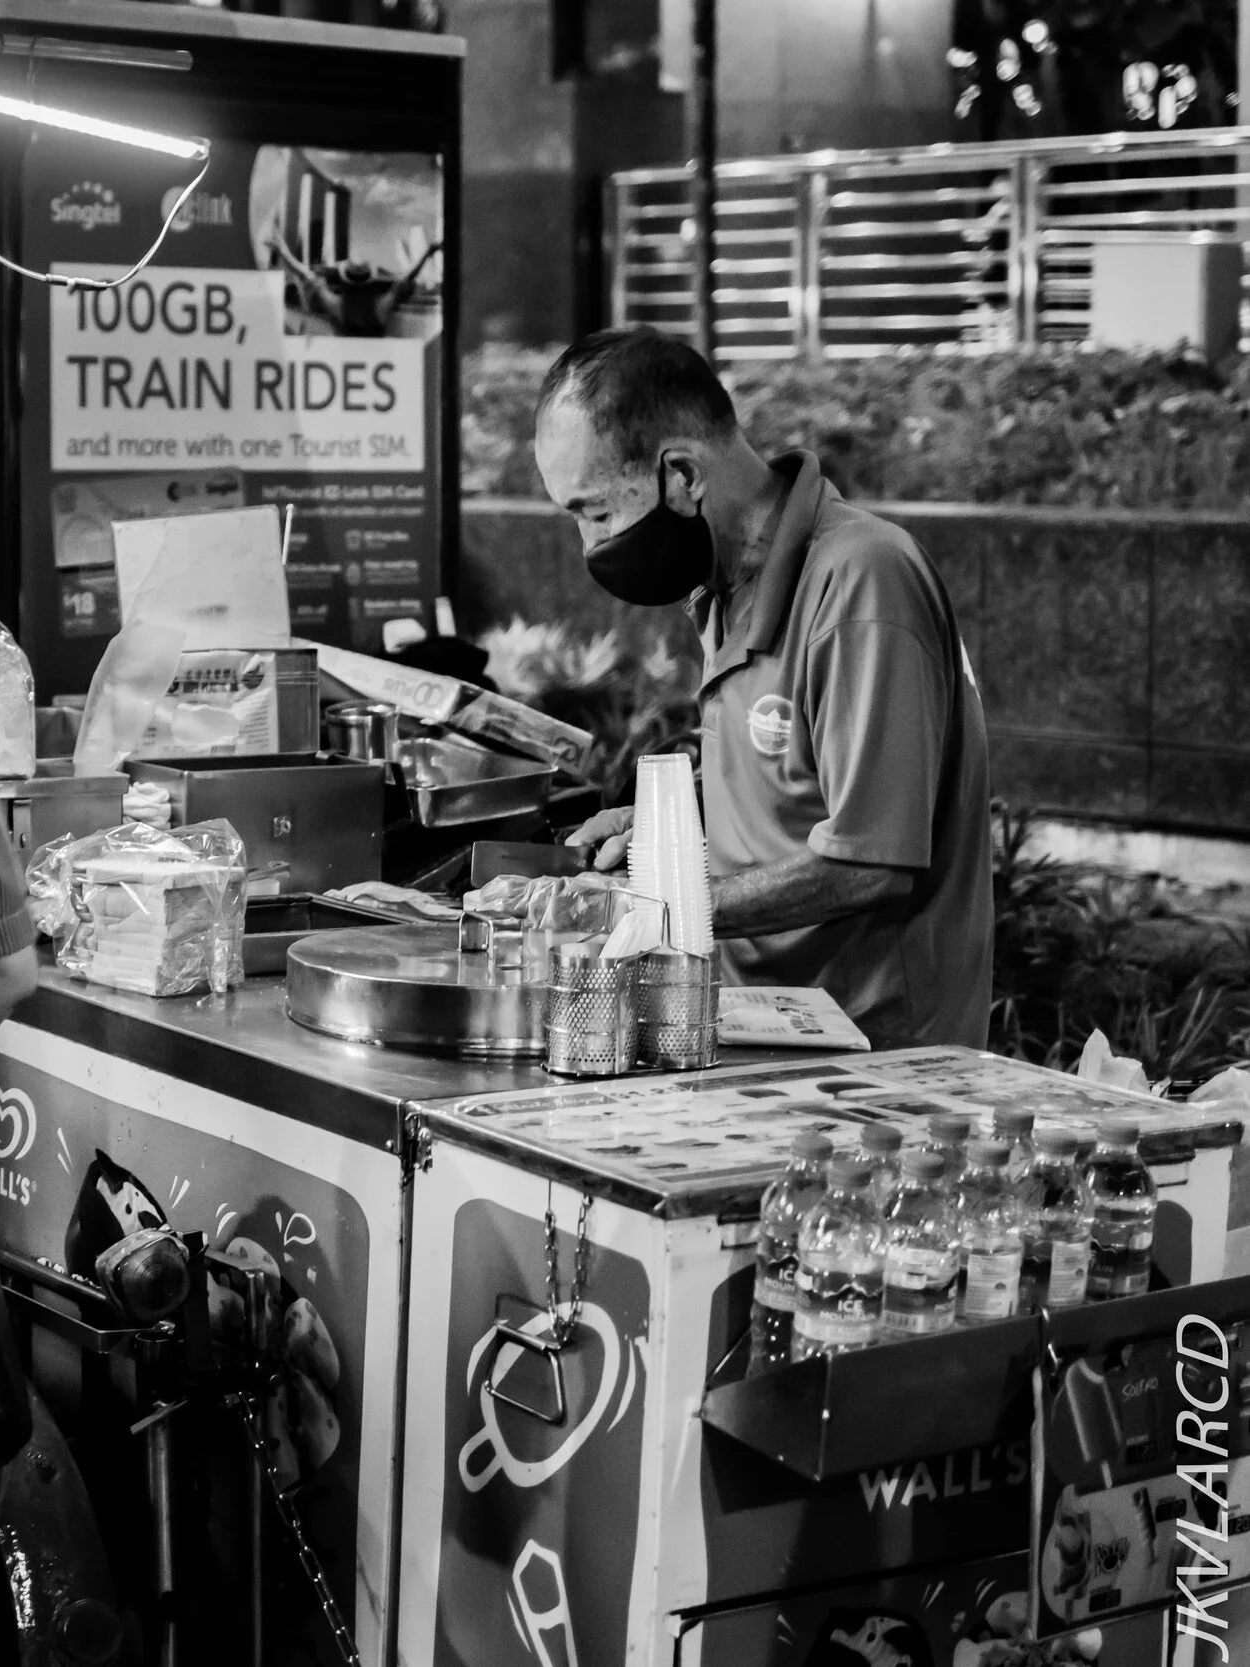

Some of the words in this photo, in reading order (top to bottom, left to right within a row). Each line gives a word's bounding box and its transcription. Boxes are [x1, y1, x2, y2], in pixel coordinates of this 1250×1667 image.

[50, 198, 121, 231] Singtel
[68, 280, 247, 344] 100GB,
[67, 355, 232, 410] TRAIN
[254, 360, 397, 412] RIDES
[66, 433, 111, 456] and
[117, 438, 177, 456] more
[184, 434, 235, 456] with
[240, 438, 283, 457] one
[288, 434, 361, 457] Tourist
[778, 1268, 795, 1281] IC
[837, 1299, 863, 1312] ICE
[857, 1440, 1028, 1512] WALL'S
